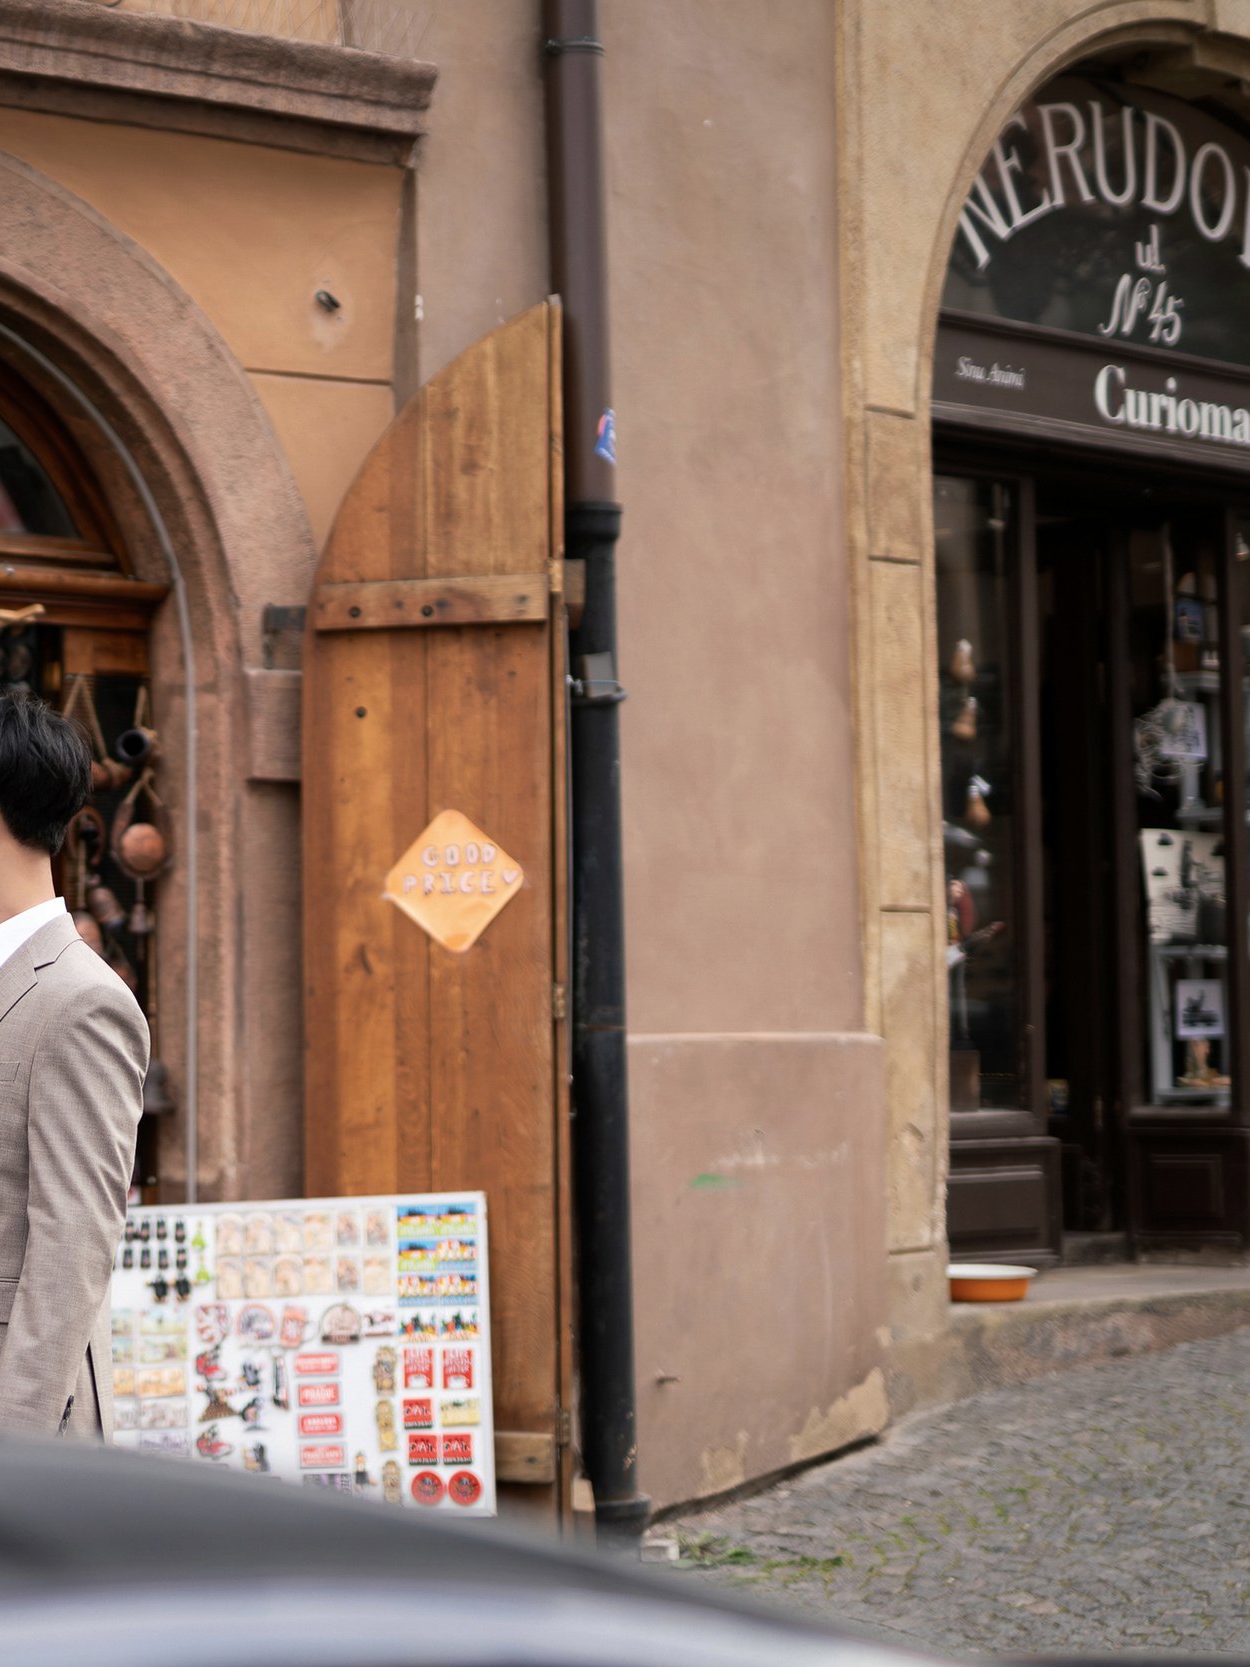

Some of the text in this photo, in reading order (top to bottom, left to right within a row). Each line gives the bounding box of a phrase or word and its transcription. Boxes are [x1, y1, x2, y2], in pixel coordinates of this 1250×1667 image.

[958, 101, 1250, 270] NERUDO
[1095, 364, 1250, 444] Curioma
[421, 842, 498, 867] GOOD
[403, 870, 495, 896] PRICE
